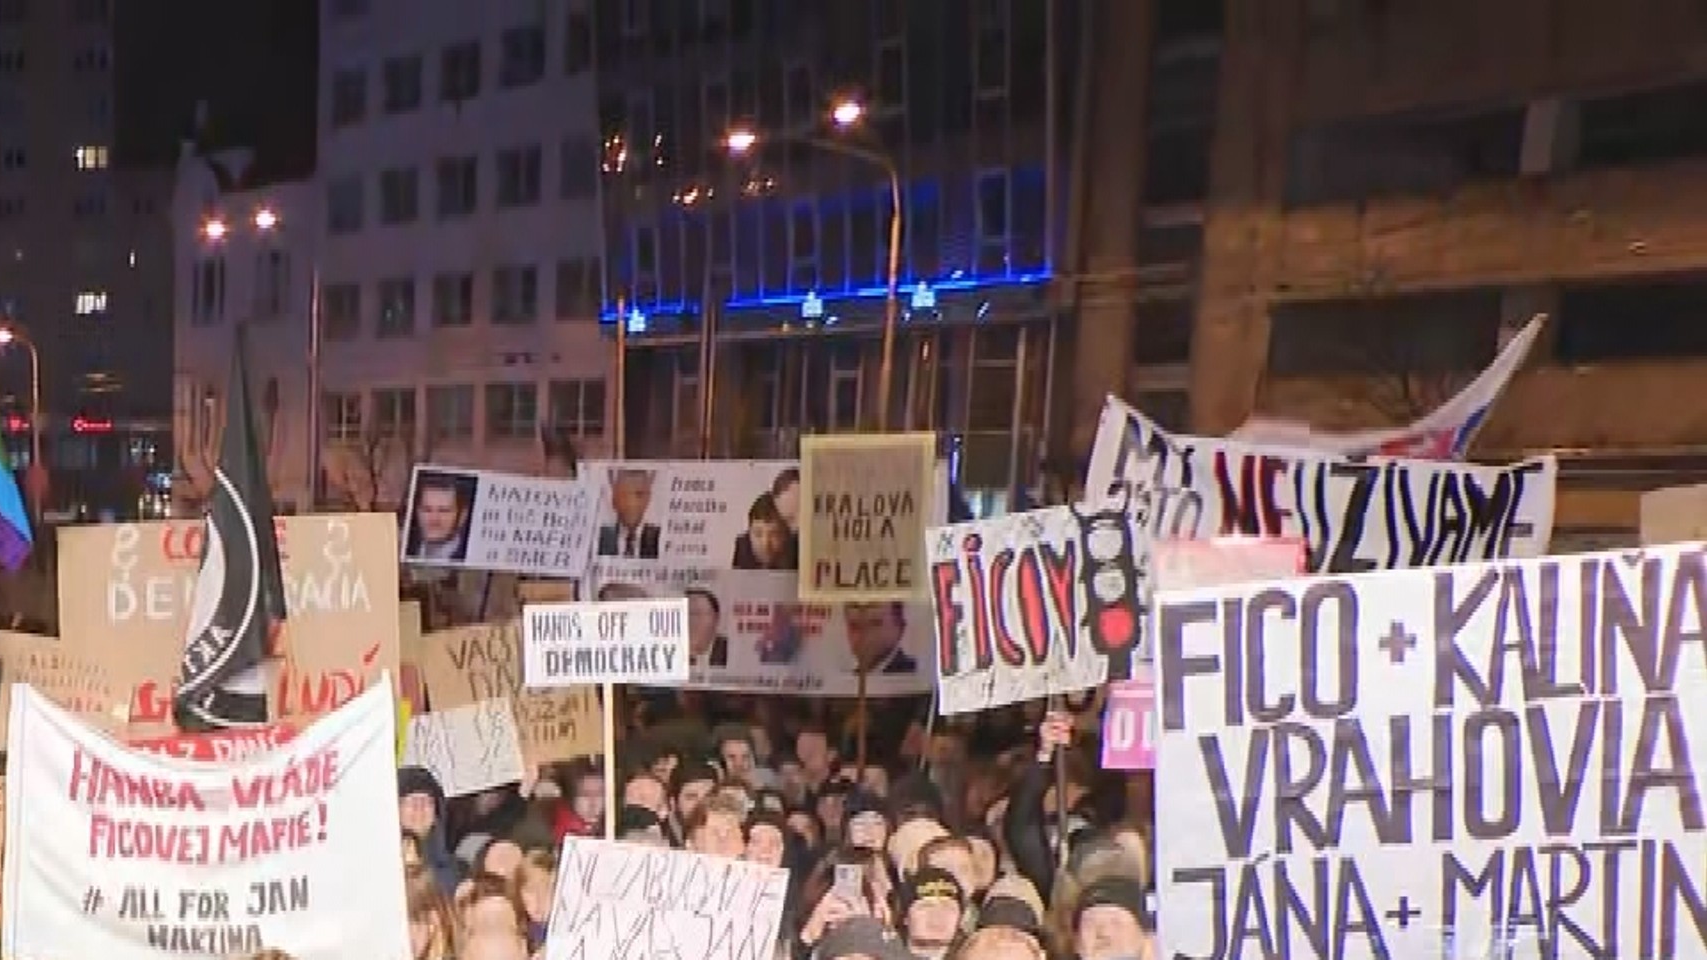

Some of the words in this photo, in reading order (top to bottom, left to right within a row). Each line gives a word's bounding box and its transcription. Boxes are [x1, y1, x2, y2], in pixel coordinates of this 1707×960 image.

[814, 557, 913, 590] PLACE
[531, 610, 582, 641] HANDS
[597, 610, 629, 641] OFF
[649, 607, 683, 639] OUR
[545, 644, 677, 677] DEMOCRACY
[1158, 580, 1360, 731] FICO
[1377, 620, 1418, 664] +
[1197, 696, 1707, 860] VRAHOVIA
[88, 813, 209, 866] FICOVEJ
[219, 803, 328, 865] MAFIE!
[118, 885, 165, 919] ALL
[178, 888, 230, 921] FOR
[246, 875, 310, 917] JAN
[1384, 895, 1422, 929] +
